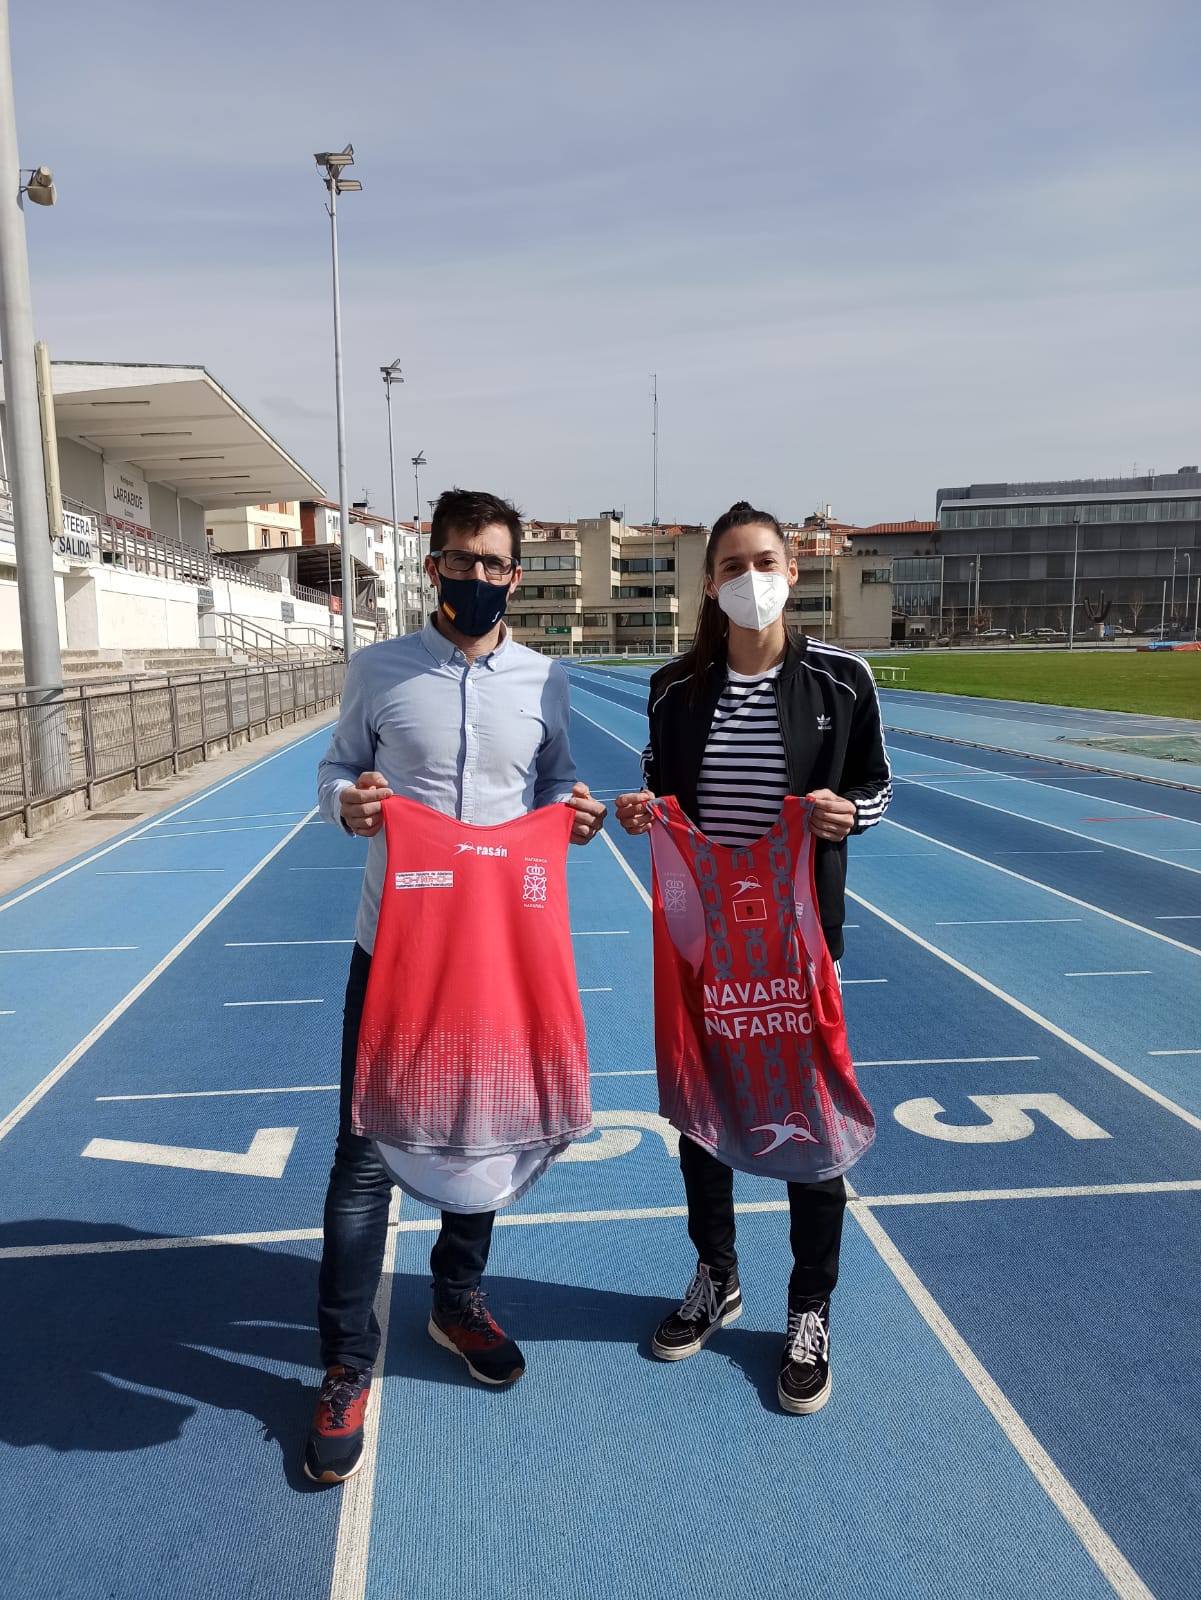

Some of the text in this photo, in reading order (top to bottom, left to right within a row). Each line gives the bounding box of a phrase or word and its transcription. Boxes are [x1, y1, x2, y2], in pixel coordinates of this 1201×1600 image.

[112, 484, 143, 510] LARRABIDE
[59, 537, 91, 558] SALIDA
[476, 845, 508, 858] rasán
[703, 1011, 818, 1040] NAFARRO
[893, 1092, 1114, 1144] 5
[80, 1126, 300, 1180] 7
